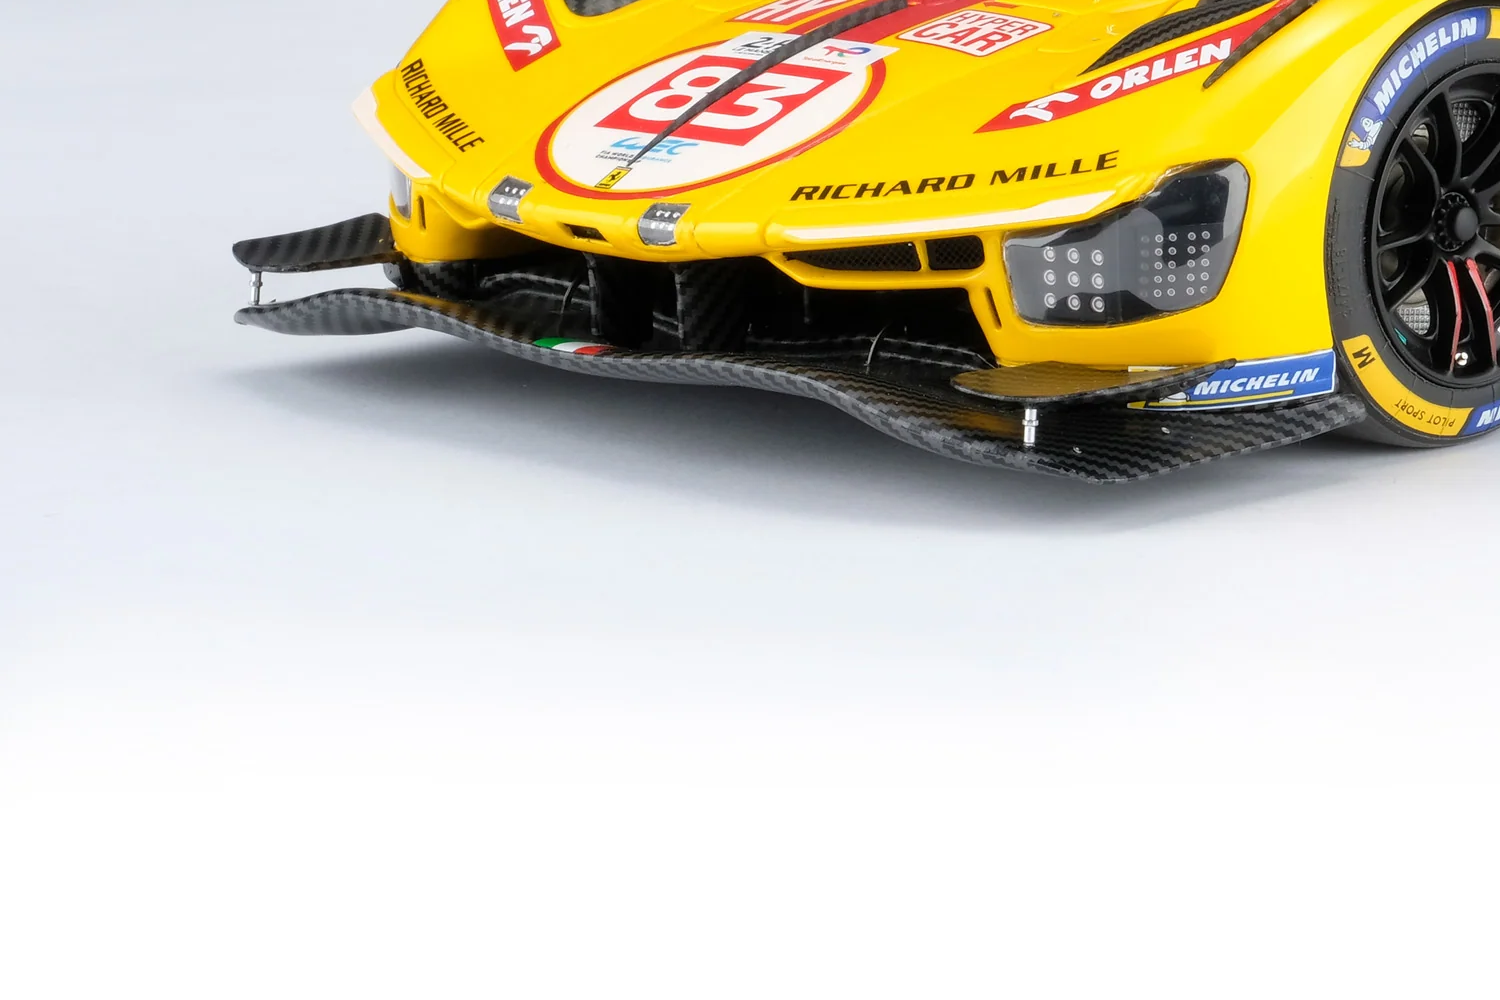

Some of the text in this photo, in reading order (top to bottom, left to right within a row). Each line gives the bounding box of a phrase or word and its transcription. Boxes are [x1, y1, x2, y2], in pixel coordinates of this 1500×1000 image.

[912, 22, 1013, 52] CAR
[947, 11, 1040, 36] HYPER
[1089, 38, 1233, 100] ORLEN
[1373, 16, 1478, 116] MICHELIN
[400, 57, 485, 153] RICHARD MILLE
[628, 65, 825, 130] 83
[790, 150, 1120, 201] RICHARD MILLE
[1351, 346, 1376, 370] M
[1193, 366, 1320, 396] MICHELIN
[1393, 398, 1456, 428] PILOT SPORT
